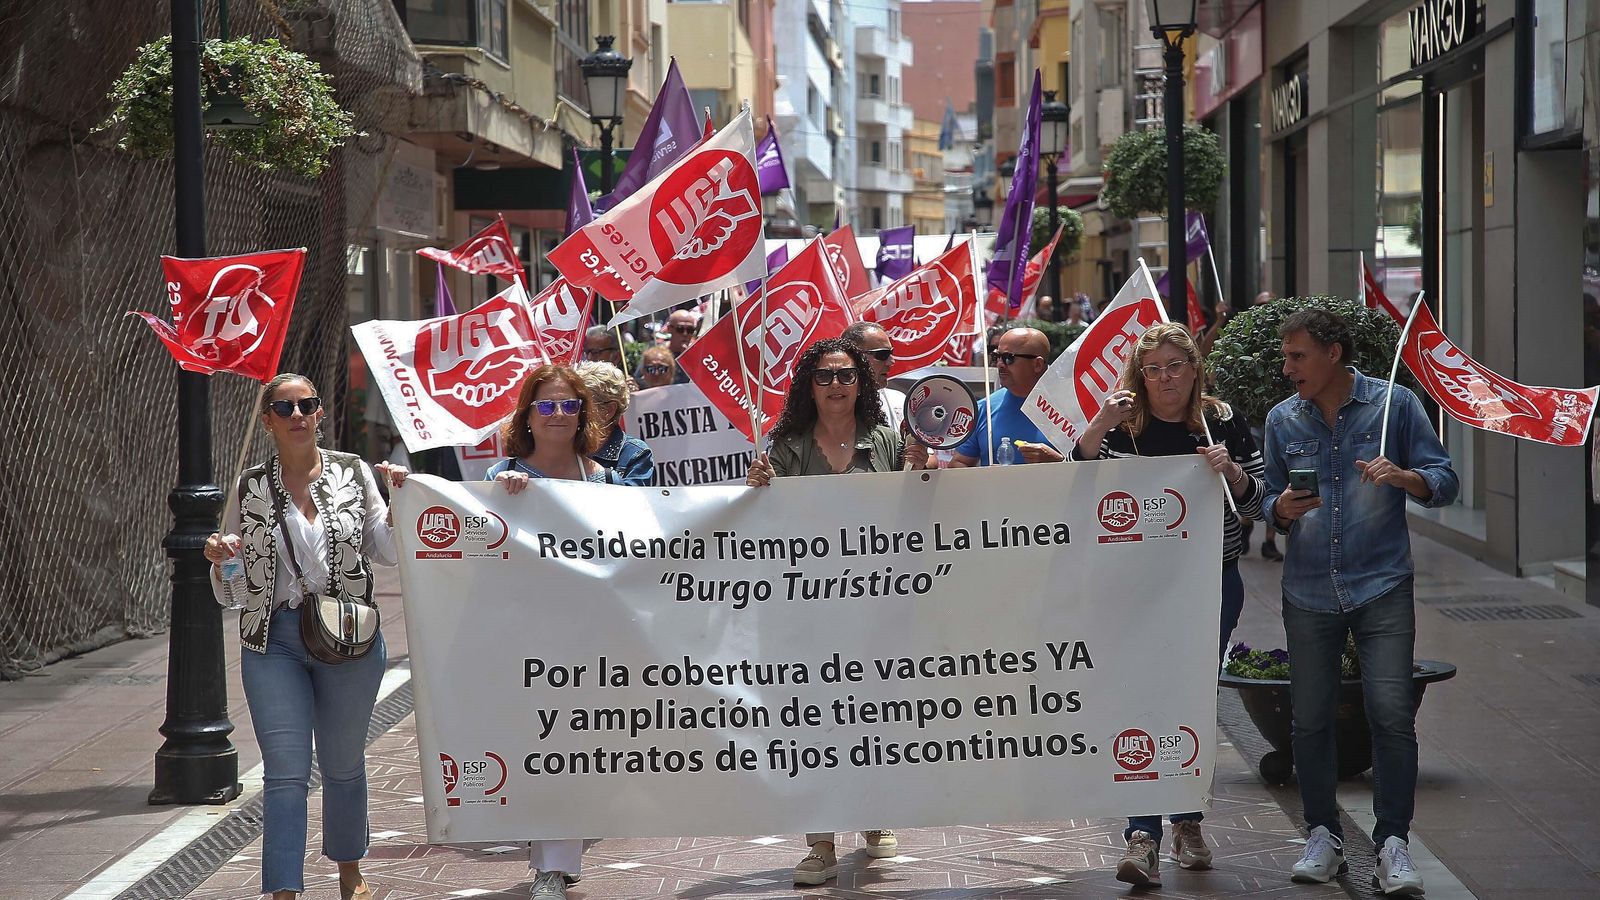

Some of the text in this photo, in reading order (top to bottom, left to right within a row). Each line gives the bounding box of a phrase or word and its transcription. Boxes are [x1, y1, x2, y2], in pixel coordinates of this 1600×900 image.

[1408, 0, 1465, 65] MANGO
[1272, 75, 1301, 132] MANGO
[655, 156, 734, 253] UGT
[874, 268, 942, 322] UGT
[431, 308, 523, 368] UGT
[422, 513, 455, 530] UGT
[1103, 498, 1133, 514] UGT
[538, 517, 1071, 567] Residencia Tiempo Libre La Línea
[524, 641, 1094, 688] Por la cobertura de vacantes YA
[537, 684, 1082, 741] y ampliación de tiempo en los
[523, 729, 1098, 778] contratos de fijos discontinuos.
[1118, 735, 1148, 752] UGT
